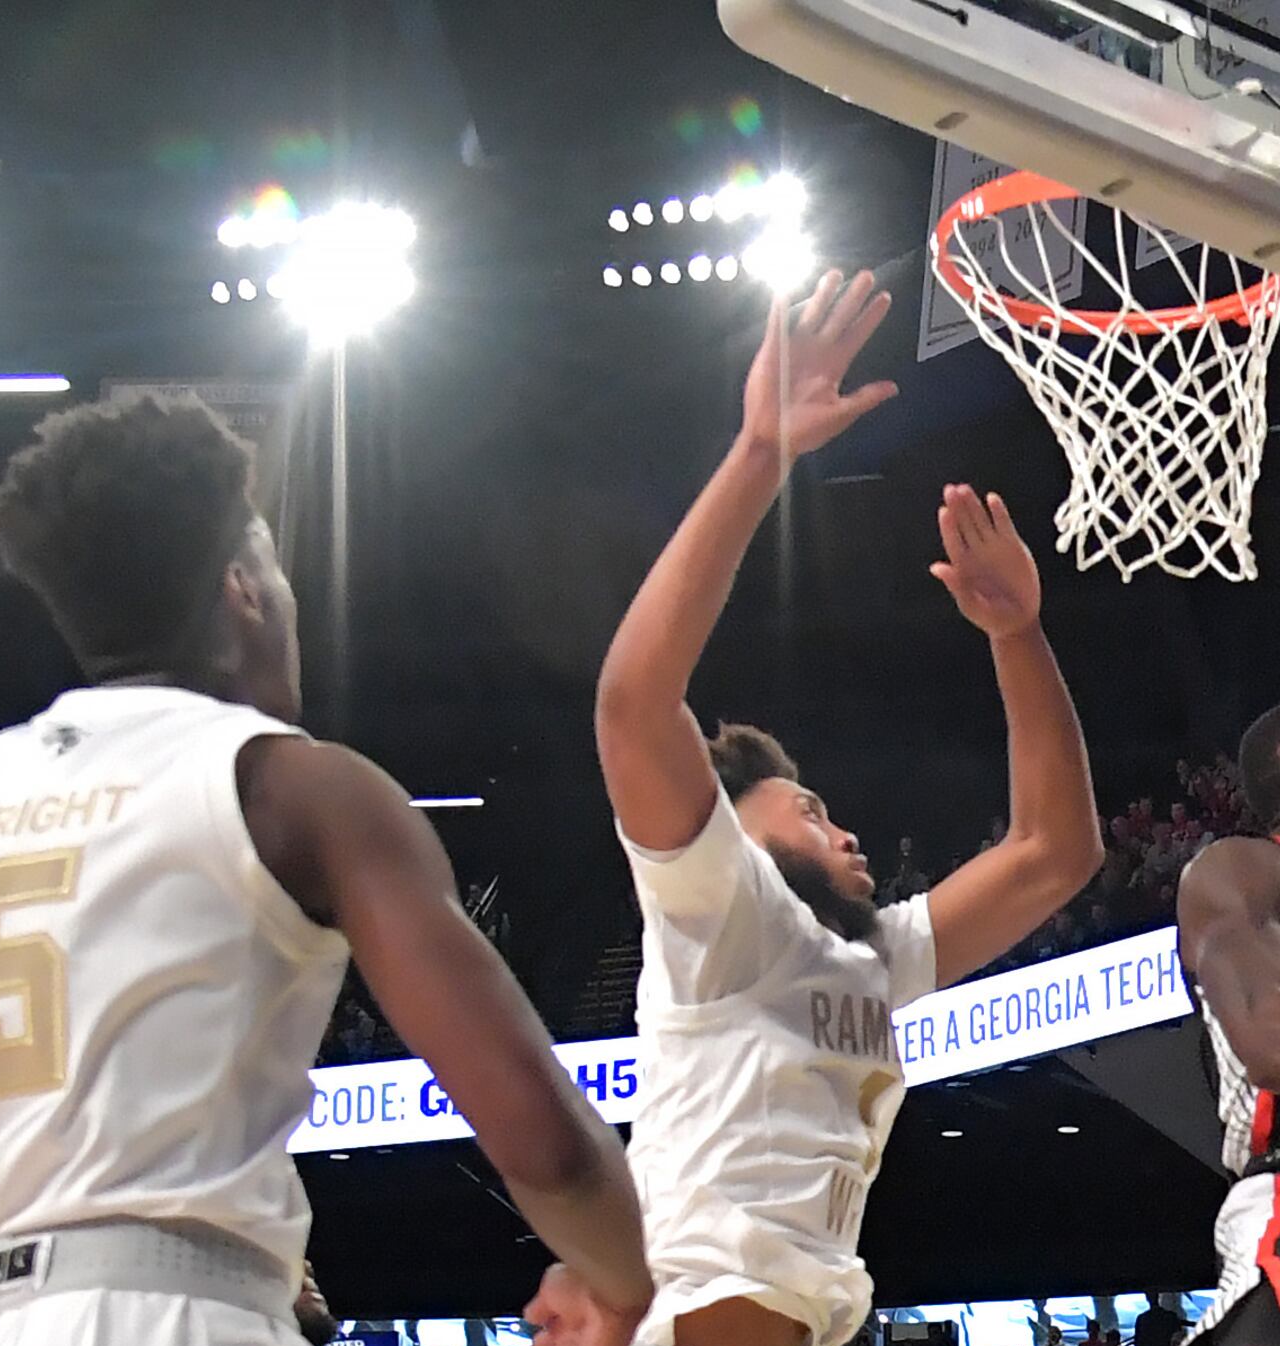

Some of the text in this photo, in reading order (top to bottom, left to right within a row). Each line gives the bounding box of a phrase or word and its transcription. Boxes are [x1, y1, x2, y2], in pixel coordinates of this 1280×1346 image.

[944, 1010, 961, 1053] A
[969, 974, 1091, 1046] GEORGIA
[1099, 948, 1178, 1011] TECH
[307, 1081, 406, 1129] CODE:
